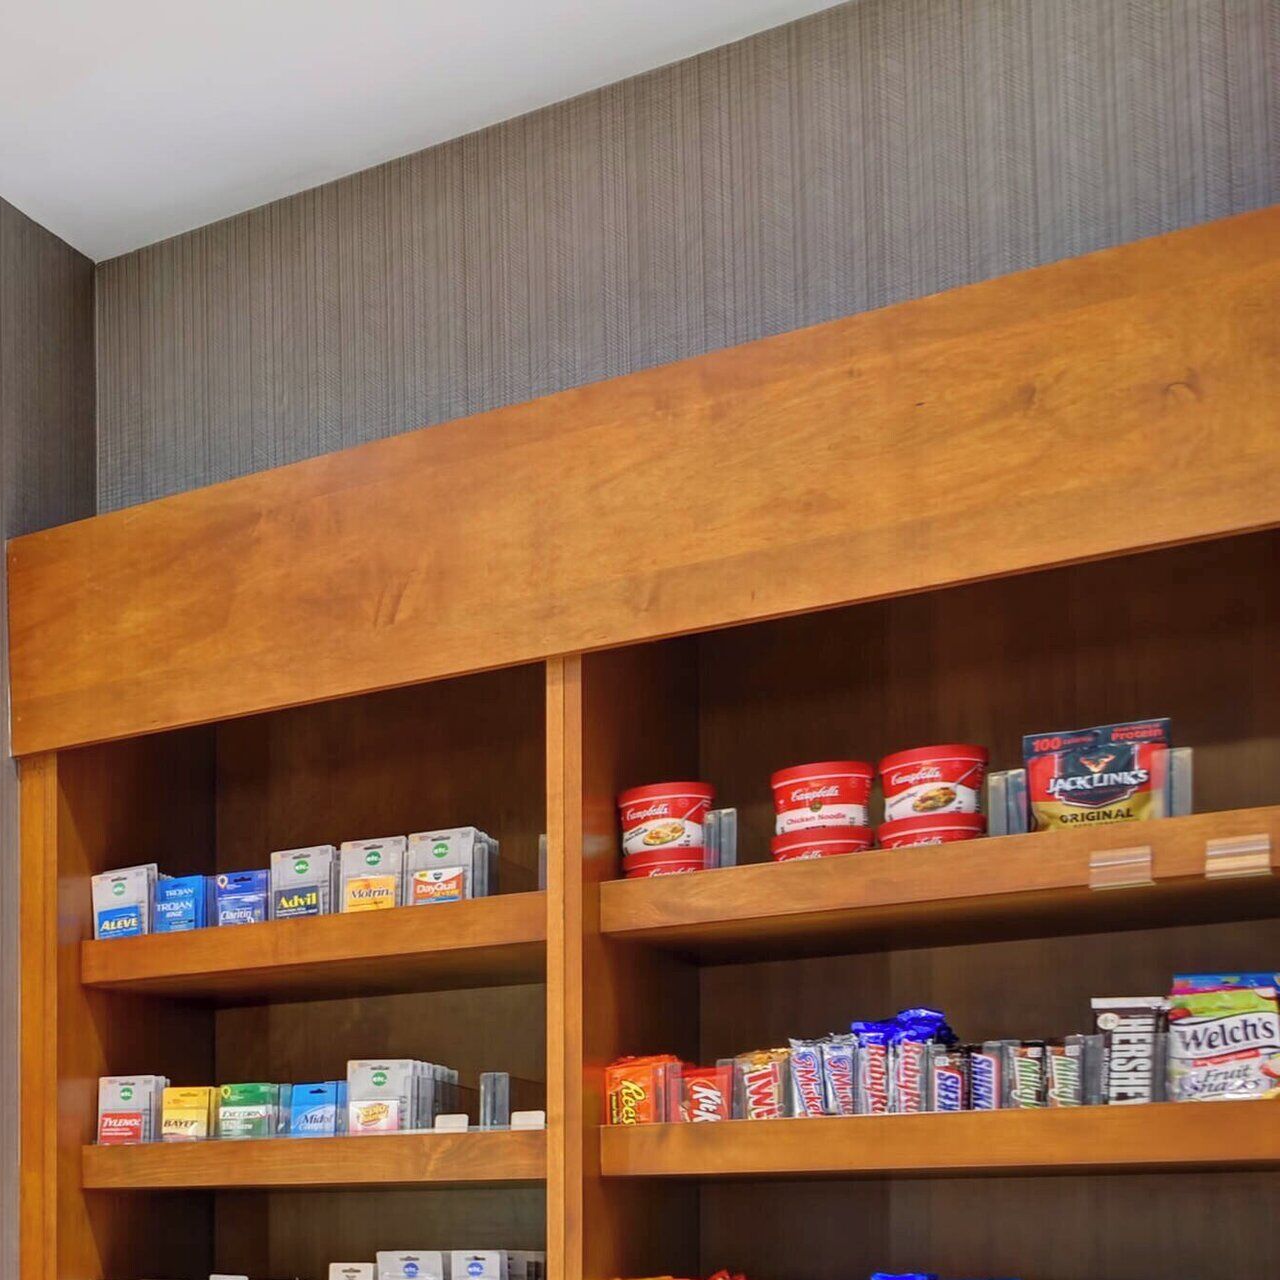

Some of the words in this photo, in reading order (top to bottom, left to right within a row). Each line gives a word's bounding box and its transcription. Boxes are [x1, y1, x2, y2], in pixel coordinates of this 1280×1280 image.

[1110, 728, 1163, 742] Protein
[1032, 737, 1062, 752] 100
[890, 768, 942, 786] Campbell's
[1046, 774, 1092, 794] JACK
[790, 786, 840, 802] Campbell's
[626, 804, 669, 820] Campbell's
[786, 815, 816, 826] Chicken
[817, 812, 848, 822] Noodle
[1059, 807, 1135, 824] ORIGINAL
[165, 887, 194, 897] TROJAN
[350, 886, 390, 899] Motrin
[416, 881, 456, 895] DayQuil
[156, 902, 194, 913] TROJAN
[278, 892, 317, 909] Advil
[220, 910, 252, 922] Claritin
[99, 917, 138, 932] ALEVE
[1177, 1018, 1275, 1051] Welch's
[1197, 1064, 1252, 1084] Fruit
